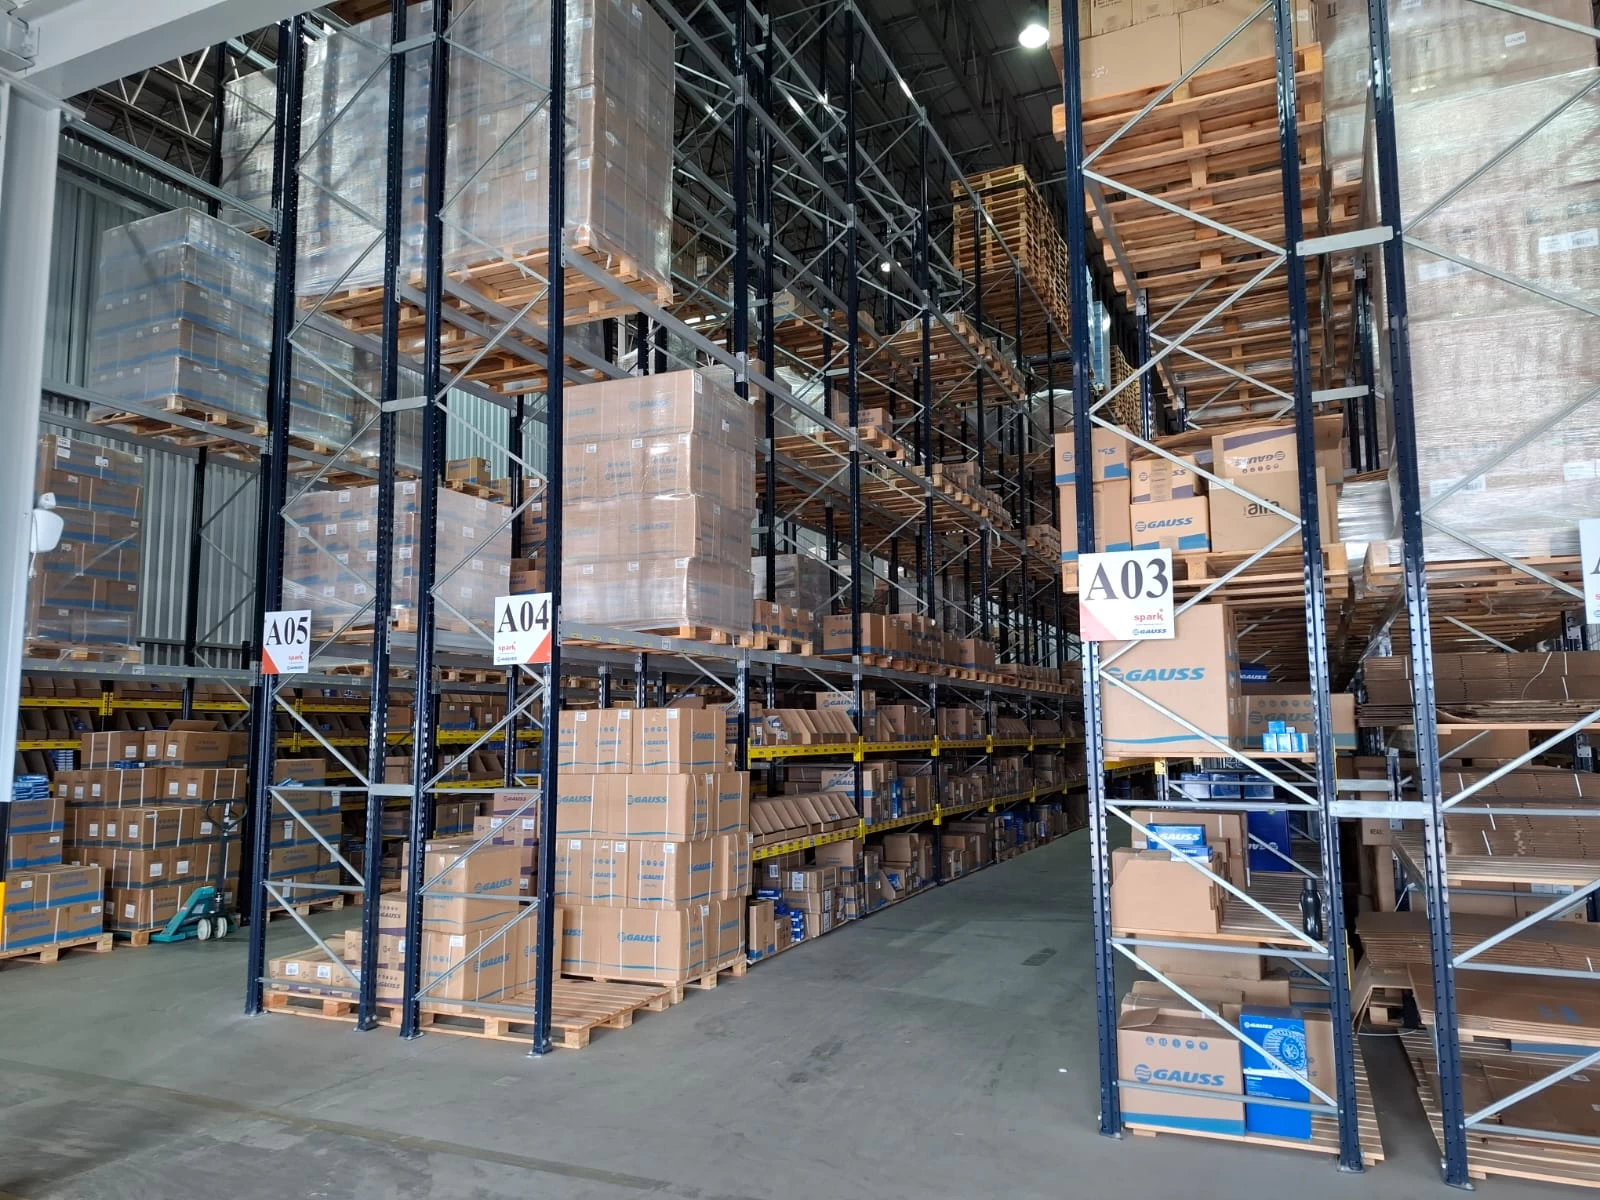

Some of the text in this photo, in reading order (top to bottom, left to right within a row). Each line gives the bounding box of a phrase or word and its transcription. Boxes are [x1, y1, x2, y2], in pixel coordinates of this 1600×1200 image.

[1147, 517, 1193, 529] GAUSS
[1085, 558, 1169, 601] A03
[497, 599, 549, 633] A04
[1134, 612, 1164, 623] spark
[266, 616, 308, 646] A05
[498, 644, 517, 653] spark
[1125, 667, 1206, 682] GAUSS
[560, 795, 593, 803] GAUSS
[635, 796, 668, 804] GAUSS
[482, 878, 513, 891] GAUSS
[626, 934, 661, 943] GAUSS
[481, 953, 509, 968] GAUSS
[1153, 1068, 1225, 1087] GAUSS
